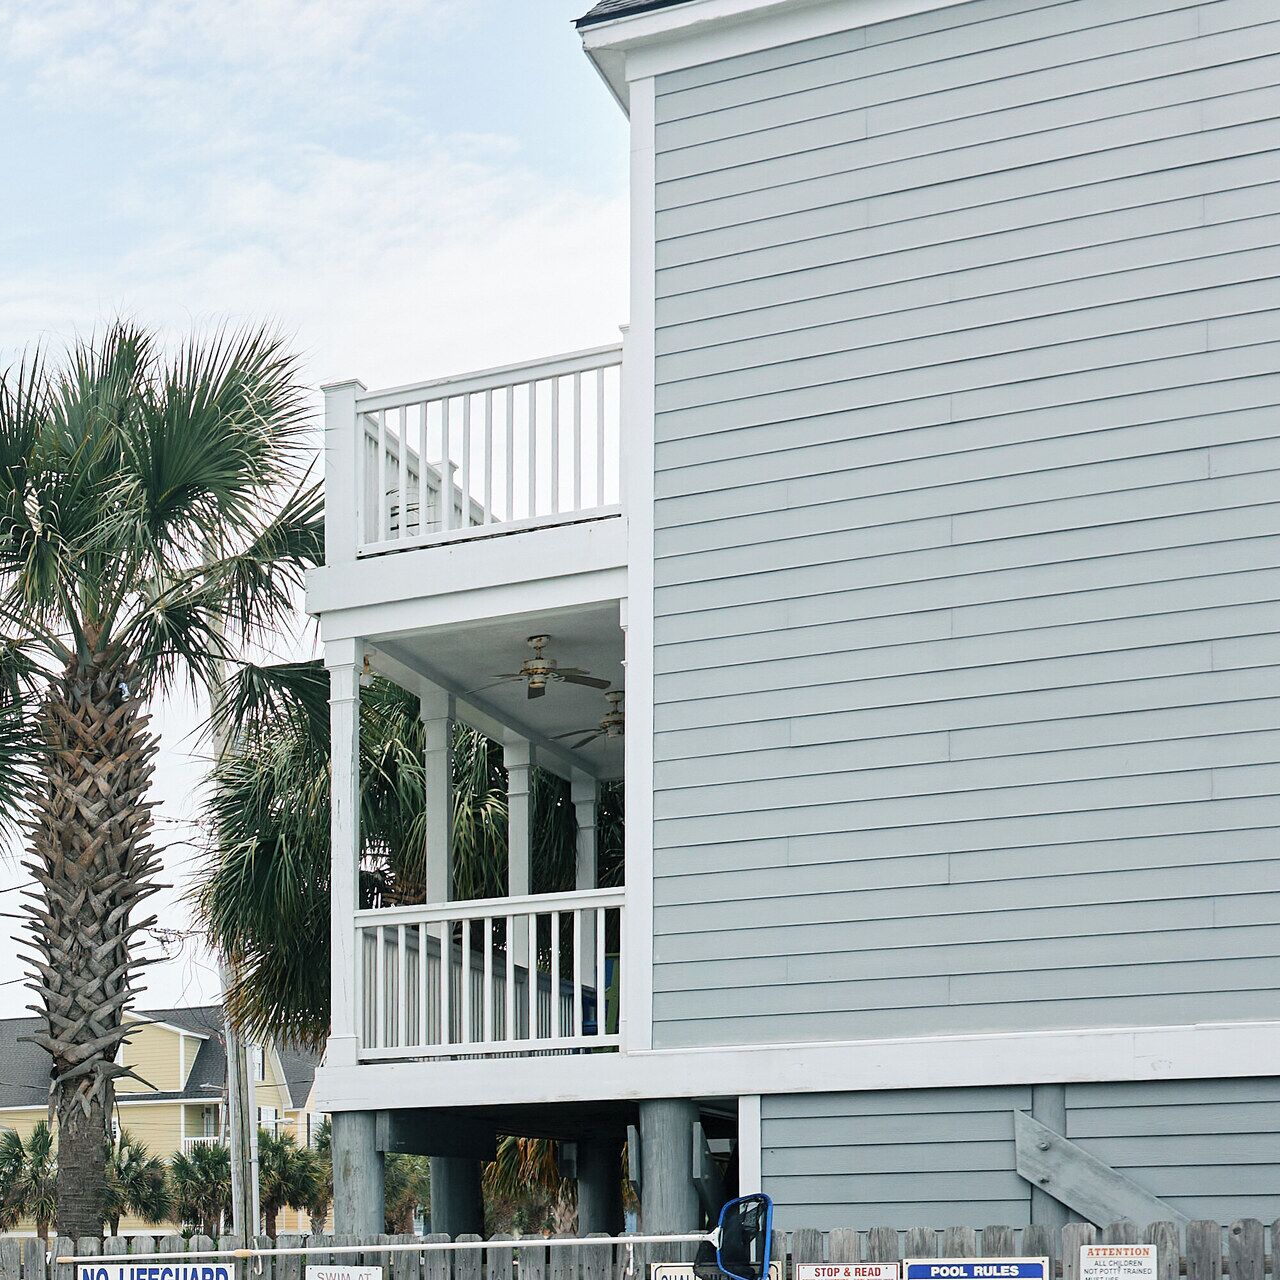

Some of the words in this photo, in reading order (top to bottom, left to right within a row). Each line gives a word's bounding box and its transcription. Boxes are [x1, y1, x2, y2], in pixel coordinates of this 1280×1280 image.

[1087, 1247, 1150, 1256] ATTENTION
[814, 1267, 840, 1277] STOP
[843, 1268, 851, 1276] &
[854, 1268, 881, 1277] READ
[930, 1265, 968, 1277] POOL
[973, 1265, 1019, 1277] RULES
